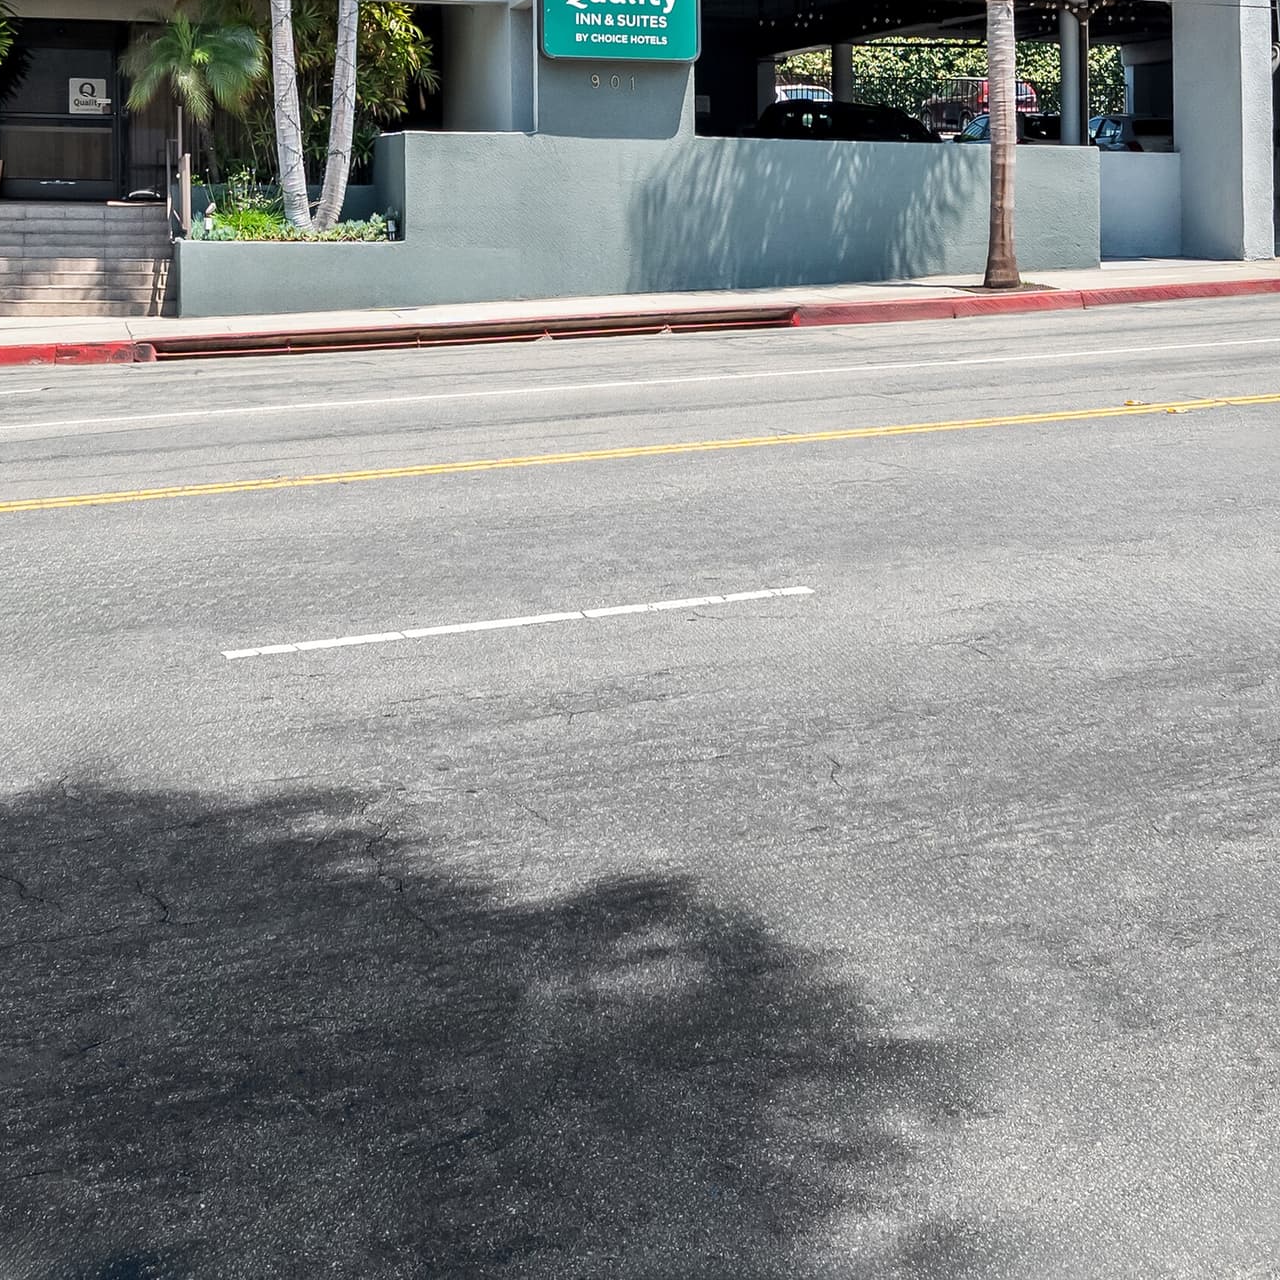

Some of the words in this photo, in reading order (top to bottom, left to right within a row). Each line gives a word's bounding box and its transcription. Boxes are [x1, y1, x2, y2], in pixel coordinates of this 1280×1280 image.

[575, 12, 602, 26] INN
[604, 13, 615, 26] &
[617, 14, 668, 28] SUITES
[575, 32, 589, 42] BY
[591, 33, 628, 44] CHOICE
[630, 35, 668, 46] HOTELS
[79, 82, 97, 98] Q
[591, 74, 635, 90] 901
